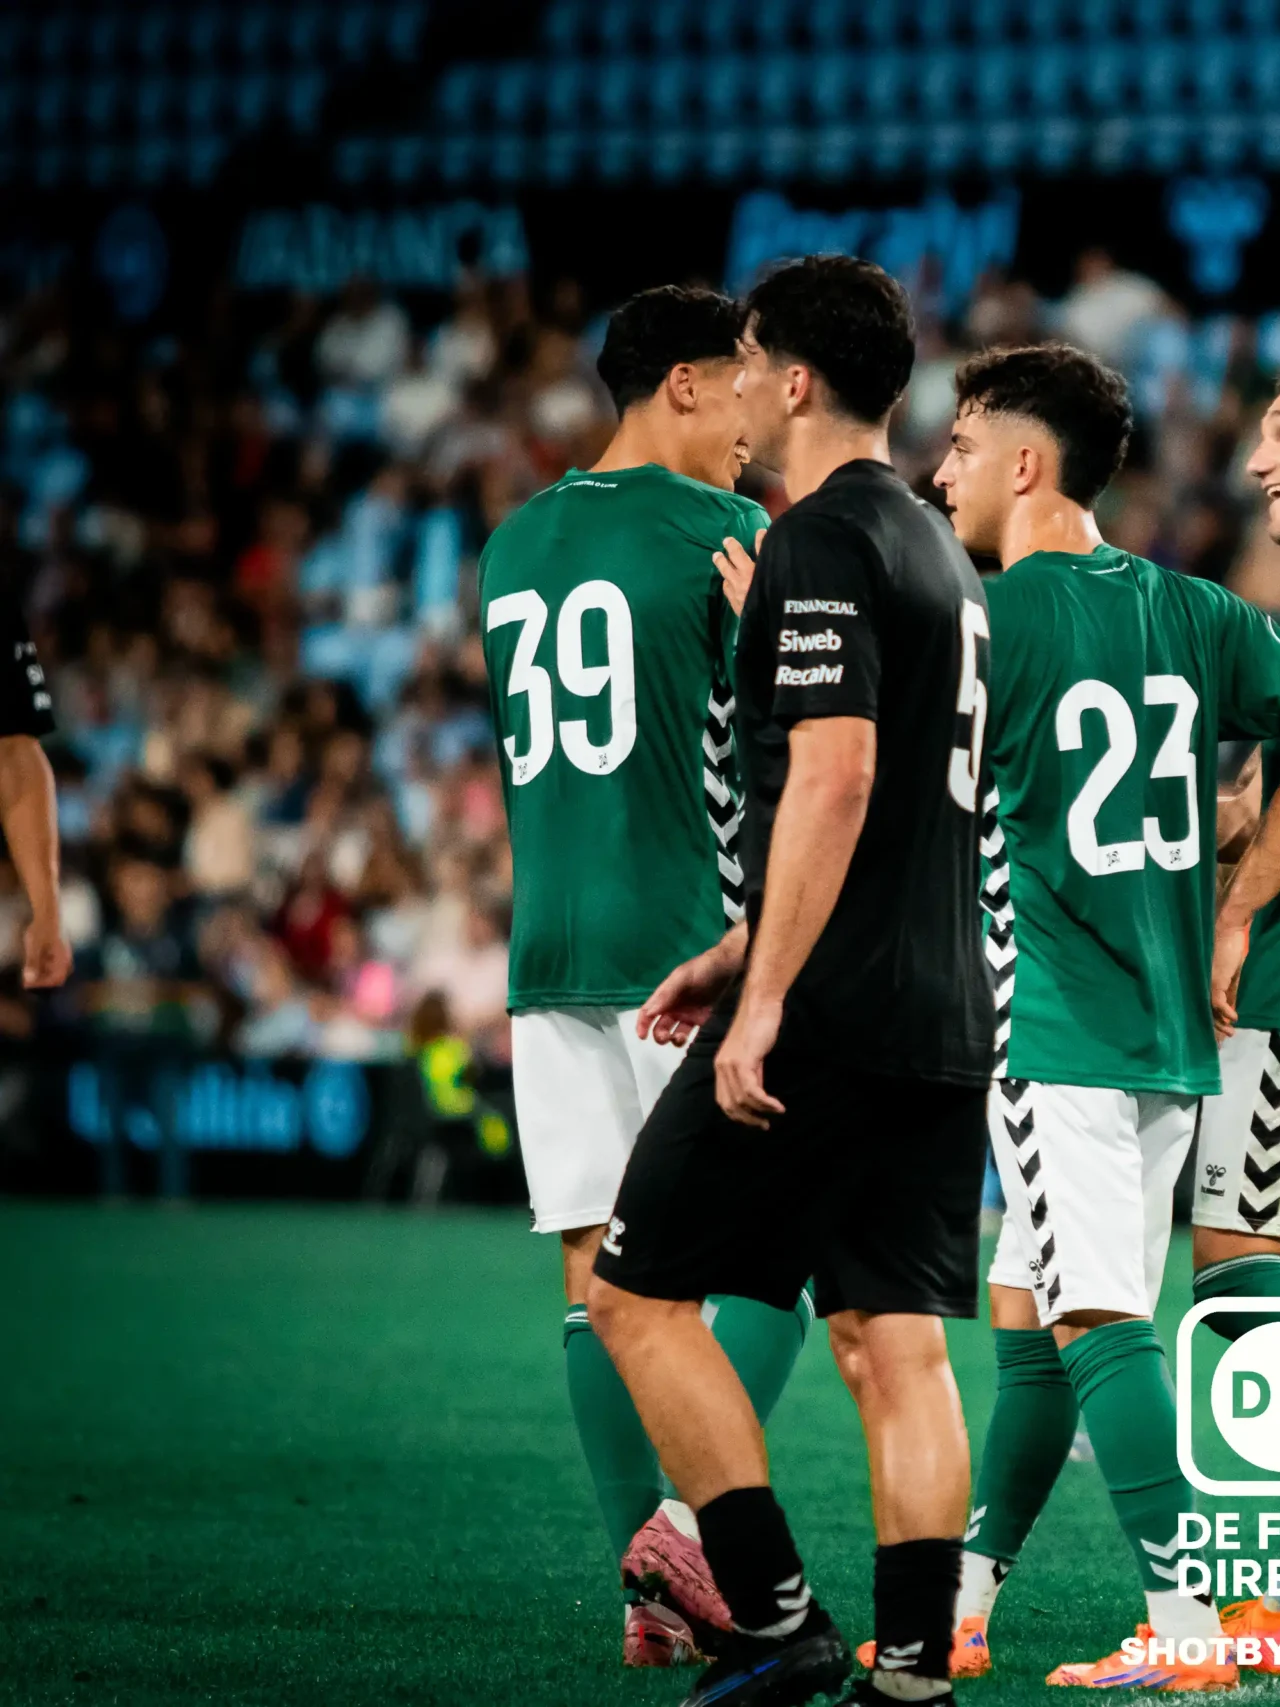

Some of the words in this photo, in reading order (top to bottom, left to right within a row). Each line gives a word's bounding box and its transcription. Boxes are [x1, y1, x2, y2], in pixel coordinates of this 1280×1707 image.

[784, 599, 859, 616] FINANCIAL
[778, 628, 842, 653] Siweb
[486, 579, 638, 786] 39
[775, 663, 844, 686] Recalvi
[1055, 674, 1201, 877] 23
